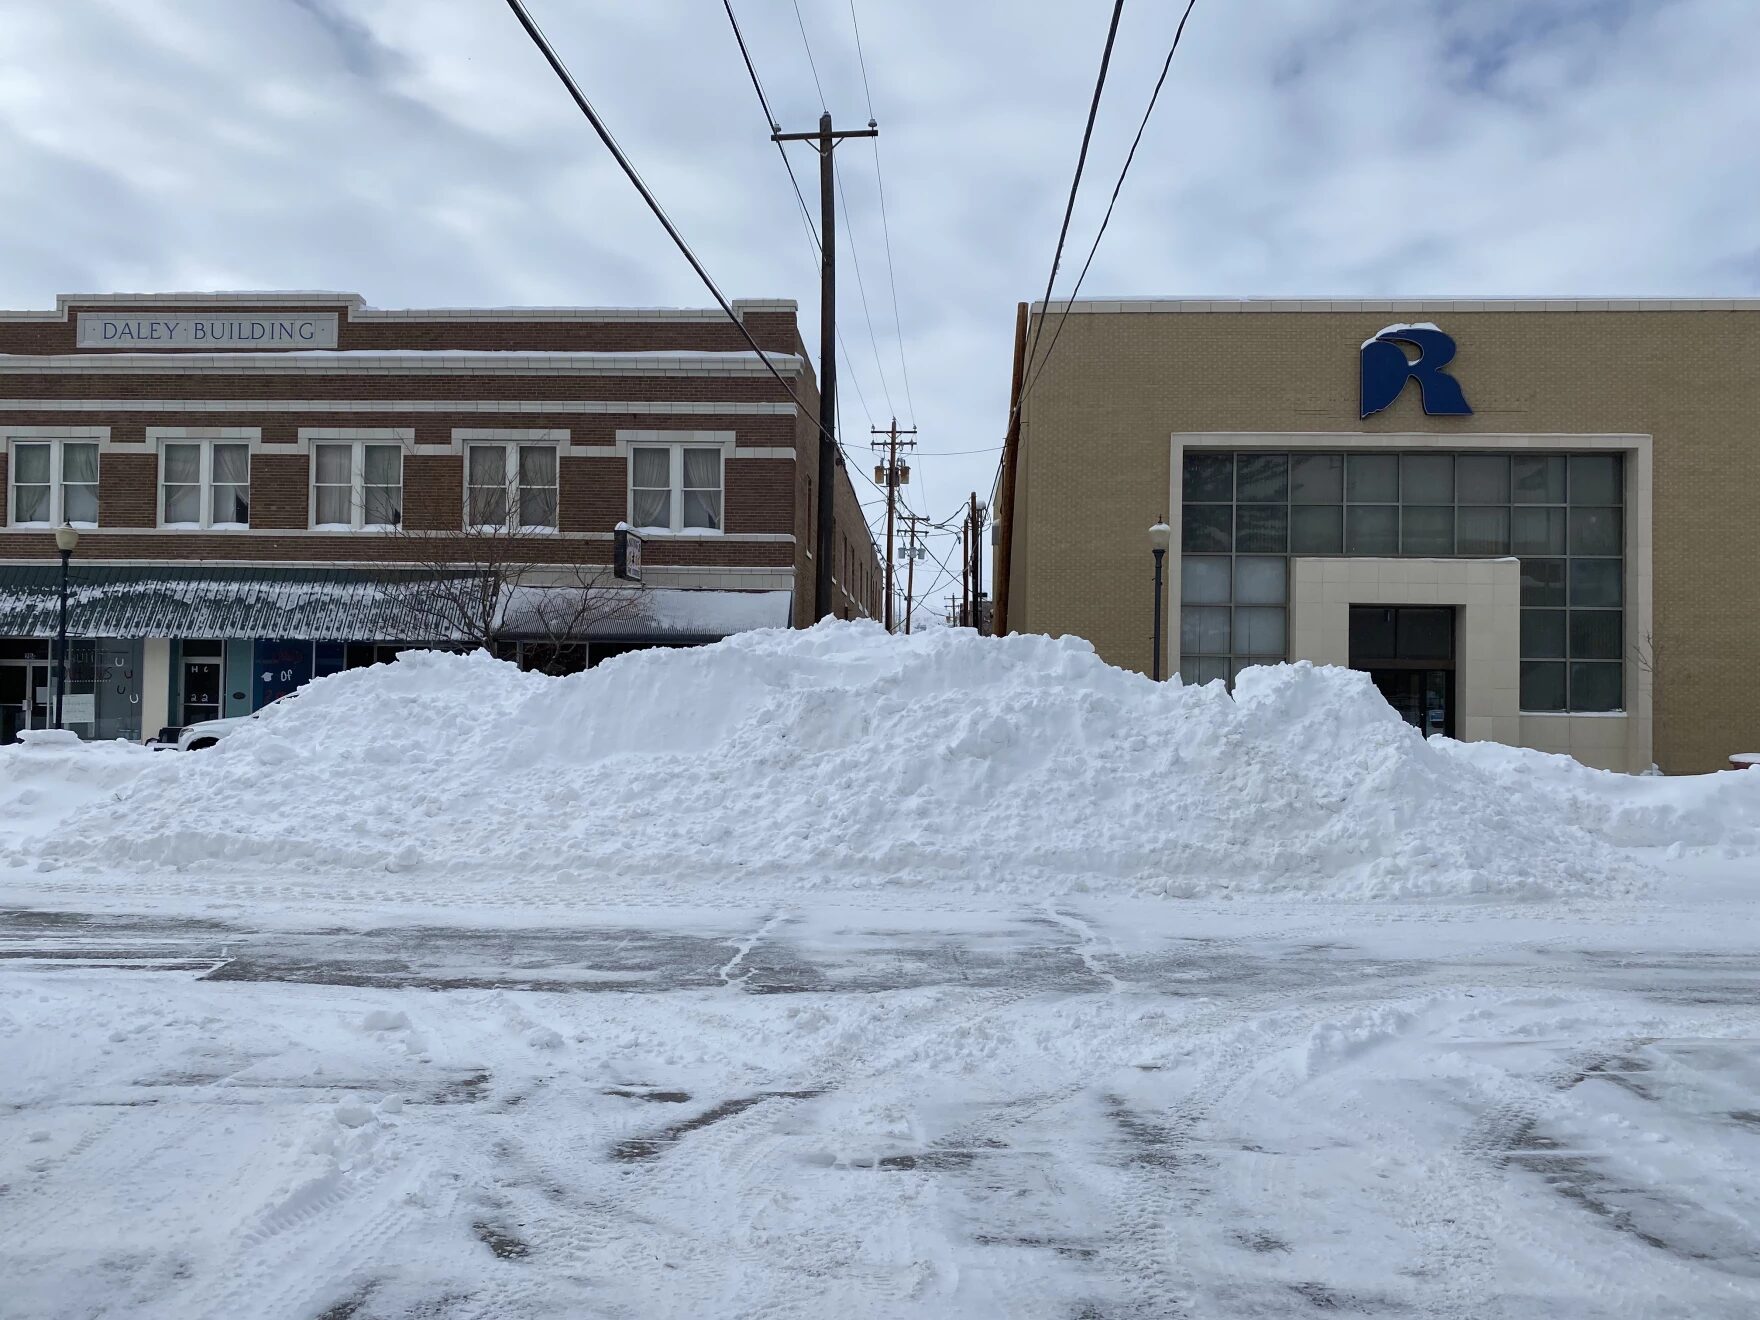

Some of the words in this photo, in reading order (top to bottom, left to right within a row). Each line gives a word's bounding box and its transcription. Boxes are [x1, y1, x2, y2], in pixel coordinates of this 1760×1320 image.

[103, 322, 180, 340] DALEY
[194, 322, 315, 341] BUILDING
[1360, 326, 1474, 421] R
